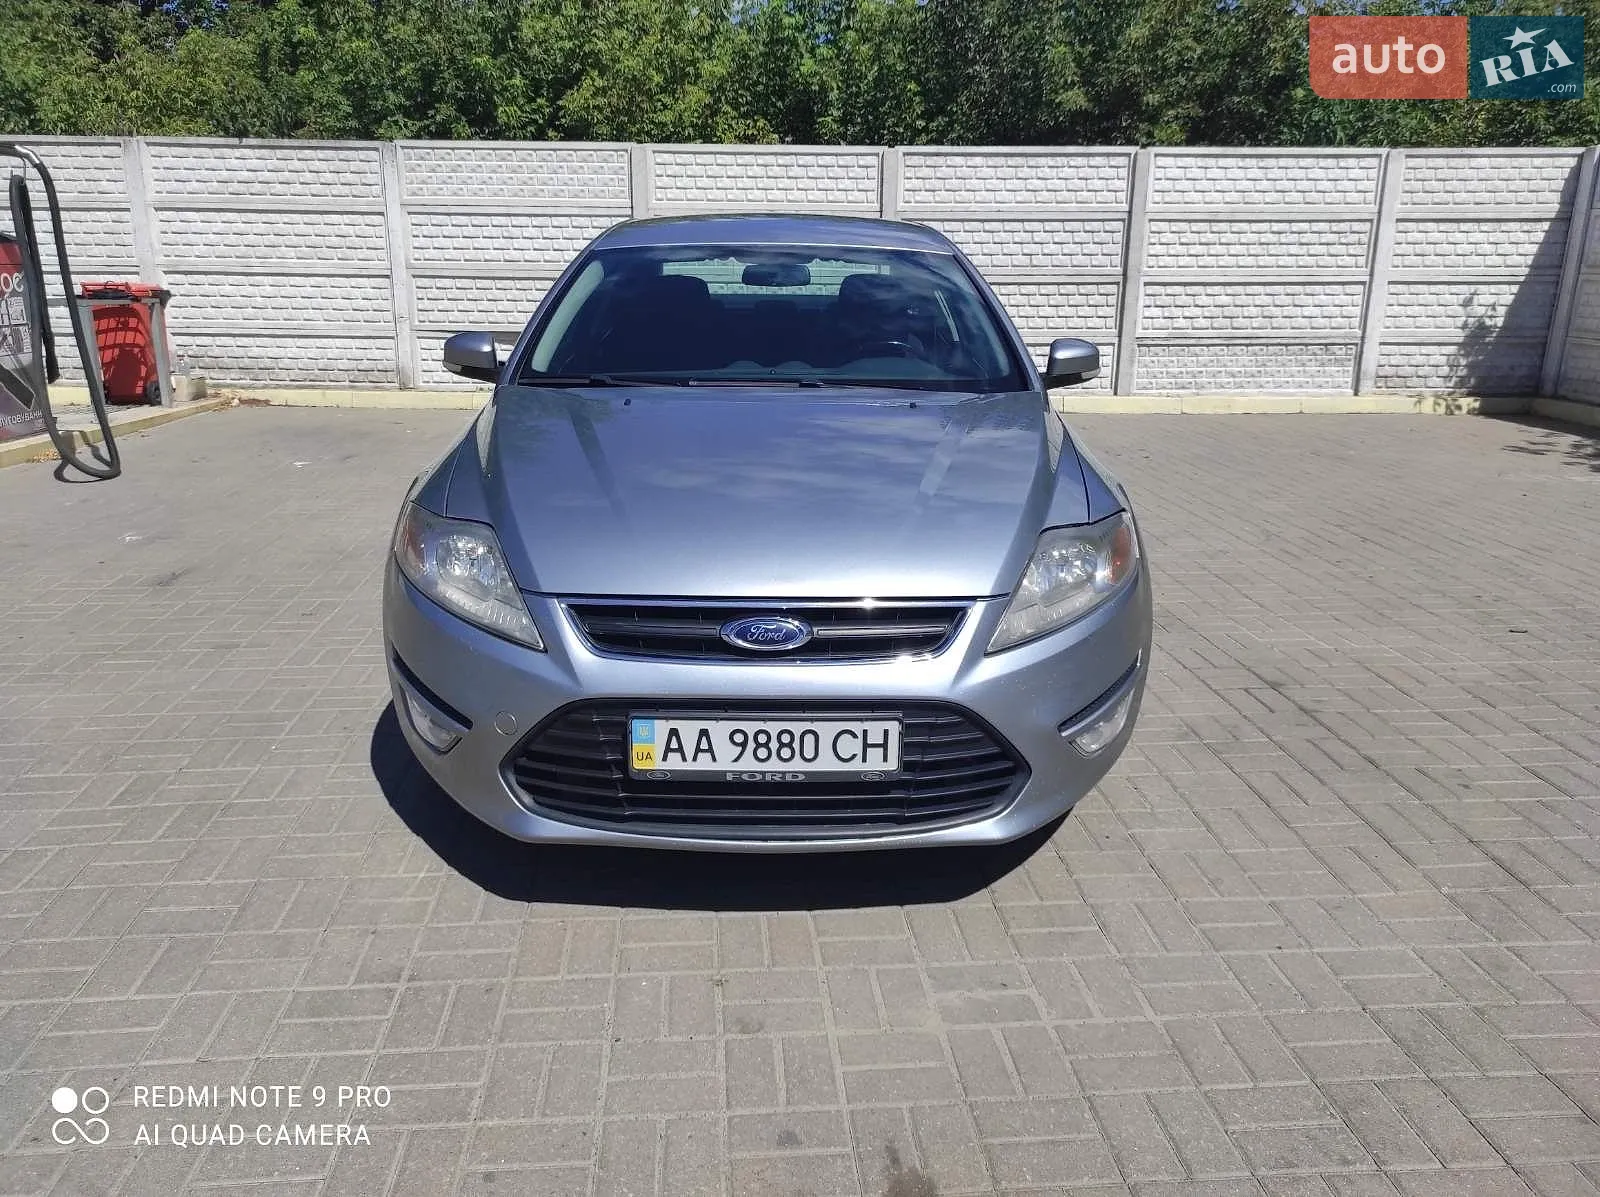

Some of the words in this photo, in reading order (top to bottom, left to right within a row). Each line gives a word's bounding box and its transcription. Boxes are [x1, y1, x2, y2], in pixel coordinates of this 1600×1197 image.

[747, 624, 786, 642] Ford
[661, 728, 717, 763] AA
[728, 728, 820, 764] 9880
[832, 728, 889, 763] CH
[636, 751, 653, 762] UA
[726, 772, 806, 782] FORD
